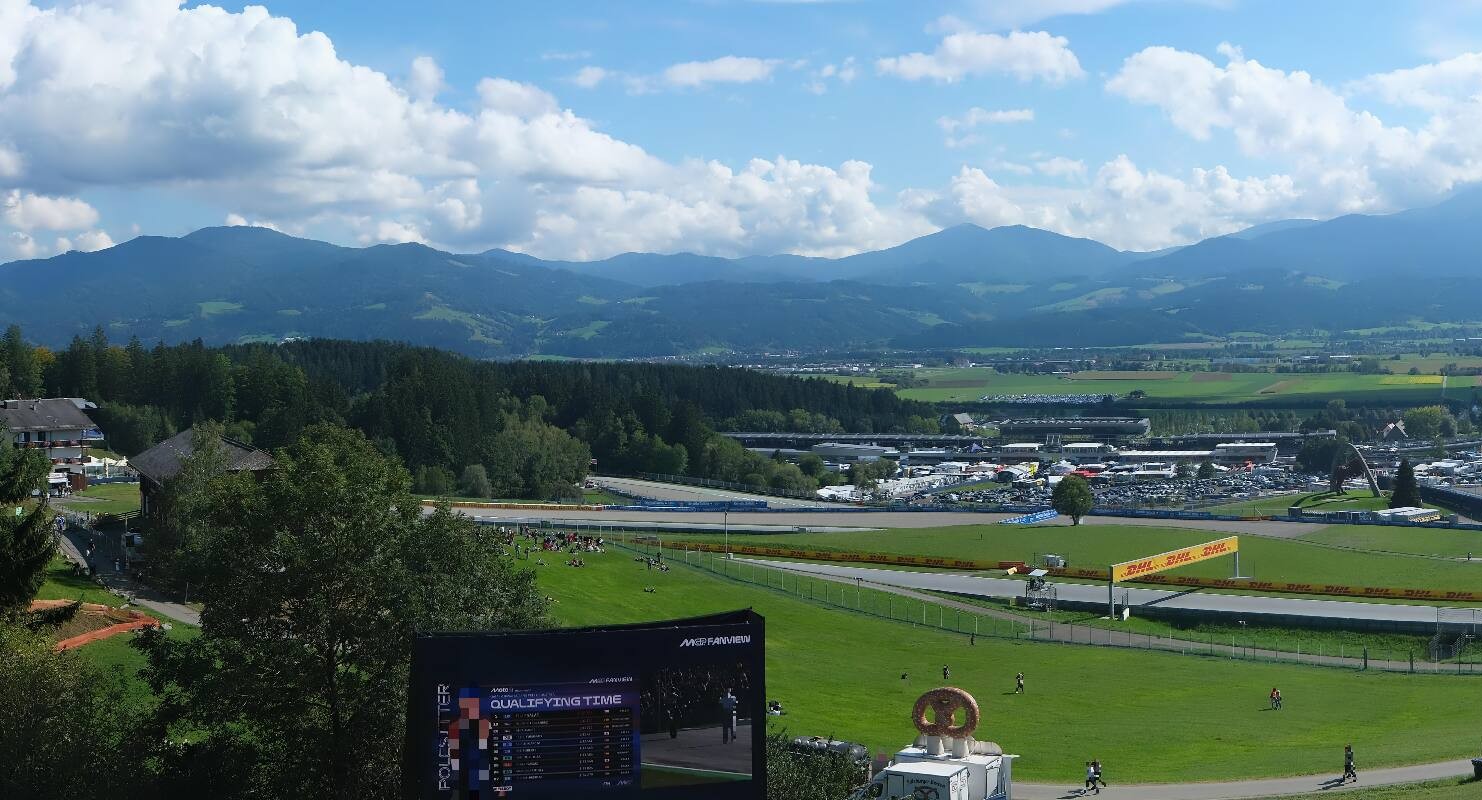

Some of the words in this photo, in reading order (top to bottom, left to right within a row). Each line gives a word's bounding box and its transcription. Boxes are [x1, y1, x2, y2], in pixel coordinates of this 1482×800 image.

[1204, 543, 1227, 556] DHL
[1166, 552, 1192, 566] DHL
[1126, 561, 1154, 576] DHL
[708, 635, 750, 645] FANVIEW
[490, 697, 580, 708] QUALIFYING
[583, 695, 622, 705] TIME
